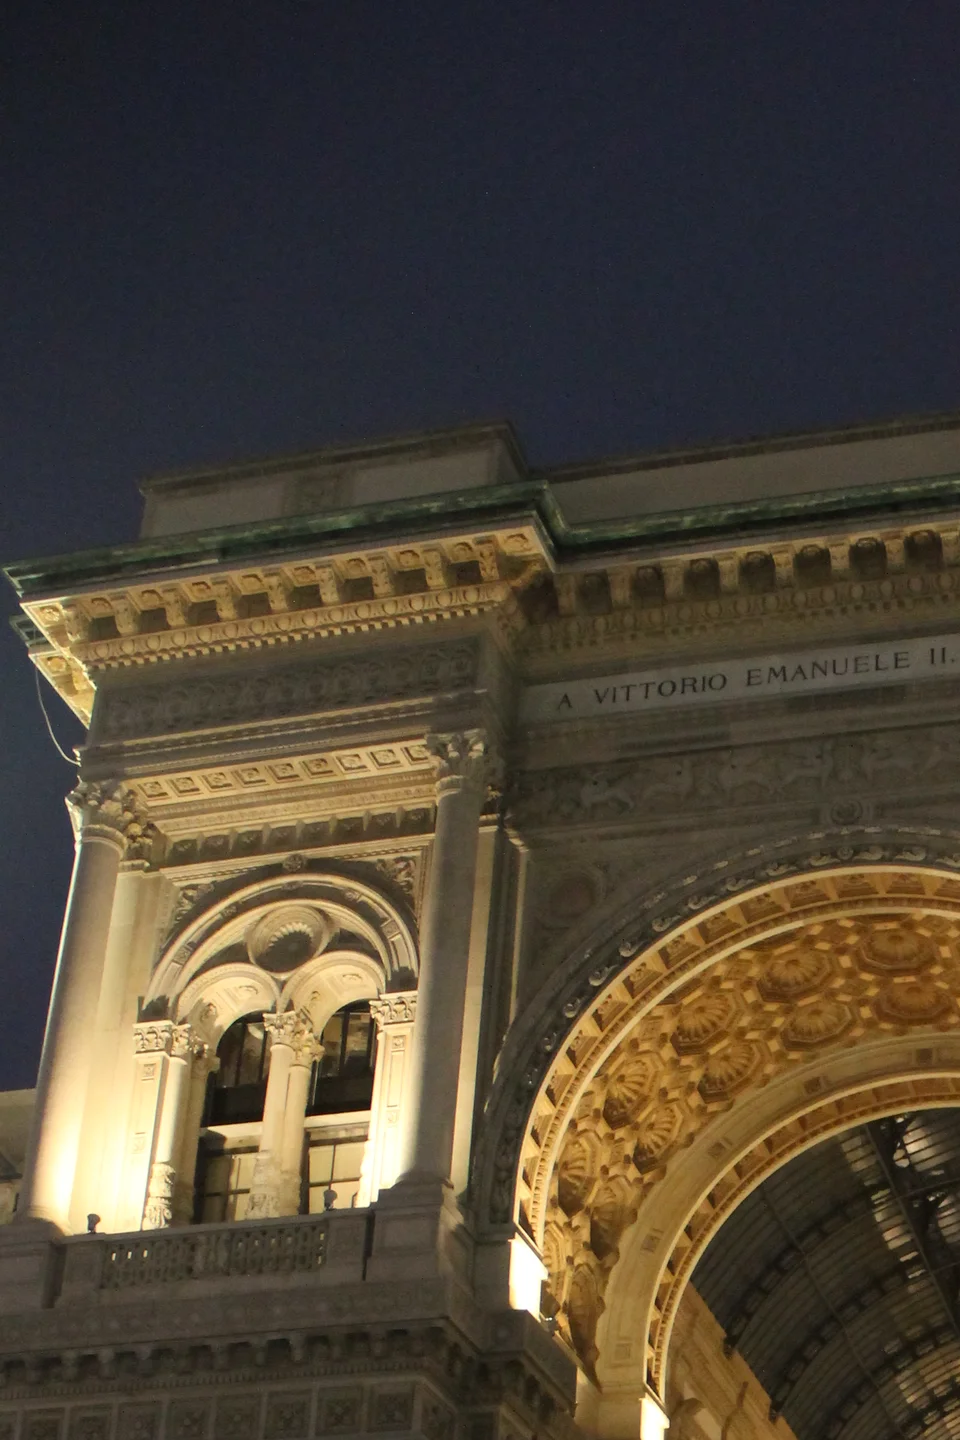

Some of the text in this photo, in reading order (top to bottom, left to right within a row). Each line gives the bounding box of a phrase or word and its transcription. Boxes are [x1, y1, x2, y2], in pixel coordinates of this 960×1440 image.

[556, 692, 573, 711] A
[593, 673, 727, 705] VITTORIO
[747, 650, 911, 687] EMANUELE
